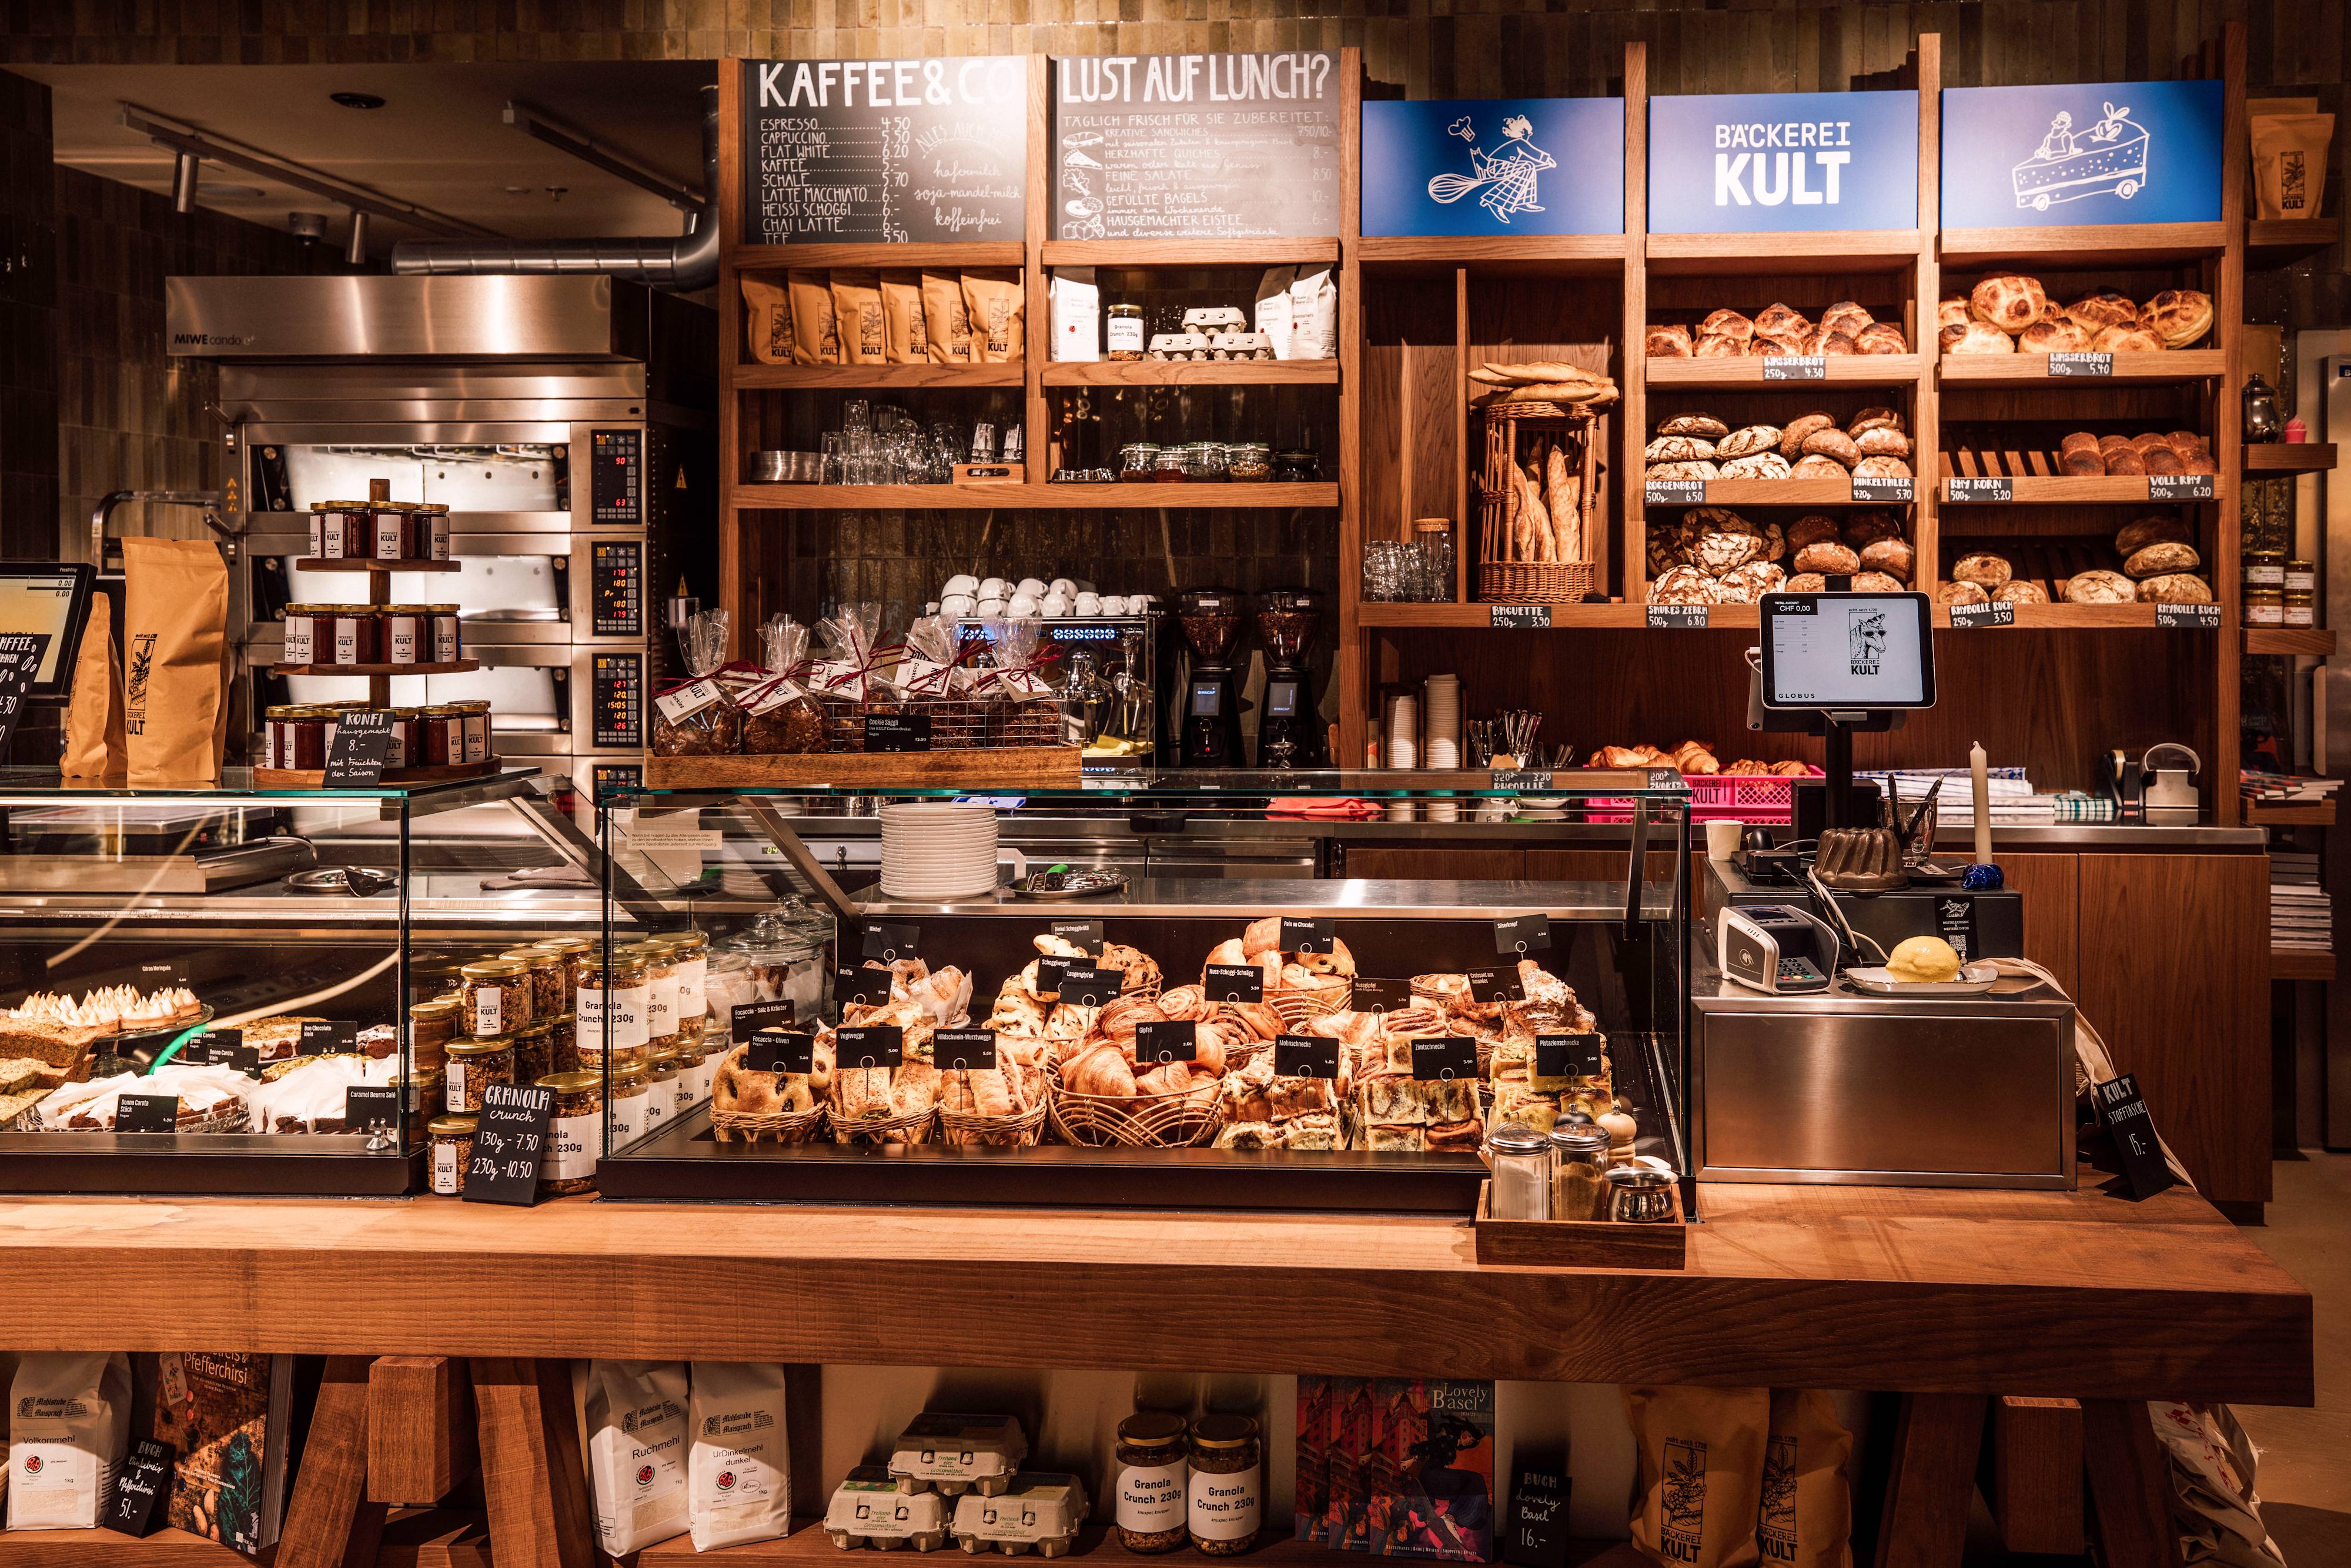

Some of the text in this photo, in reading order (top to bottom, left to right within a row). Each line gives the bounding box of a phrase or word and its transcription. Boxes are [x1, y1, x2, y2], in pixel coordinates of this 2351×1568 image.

[1062, 54, 1330, 103] LUST AUF LUNCH?
[761, 117, 911, 131] ESPRESSO 4.50
[1063, 112, 1329, 127] TÄGLICH FRISCH FÜR SIE ZUBEREITET:
[761, 131, 910, 145] CAPPUCCINO 5.50
[1715, 121, 1851, 148] BÄCKEREI
[762, 145, 908, 158] FLAT WHITE 6.20
[762, 159, 808, 172] KAFFEE
[763, 173, 908, 188] SCHALE 5.70
[1106, 169, 1191, 180] FEINE SALATE
[1715, 151, 1851, 208] KULT
[762, 188, 867, 202] LATTE MACCHIATO
[1106, 192, 1208, 206] GEFÜLLTE BAGELS
[763, 203, 851, 216] HEISSI SCHOGGI
[2282, 200, 2305, 209] KULT
[763, 218, 843, 232] CHAI LATTE
[934, 207, 1001, 232] koffeinfrei
[1107, 215, 1243, 226] HAUSGEMACHTER EISTEE
[174, 334, 208, 345] MIWE
[861, 346, 881, 355] KULT
[1764, 357, 1825, 366] WASSERBROT
[2050, 353, 2112, 363] WASSERBROT
[1764, 367, 1824, 379] 250g 4.30
[2050, 364, 2110, 375] 500g 5.40
[1647, 481, 1703, 490] ROGGENBROT
[1853, 479, 1911, 487] DINKELTALER
[1950, 479, 2001, 489] RHY KORN
[2151, 476, 2201, 486] VOLL RHY
[1647, 492, 1703, 503] 500g 6.50
[1853, 489, 1912, 499] 420g 5.70
[1951, 490, 2011, 501] 500g 5.20
[2151, 487, 2211, 498] 500g 6.20
[1492, 606, 1543, 616] BAGUETTE
[1683, 606, 1708, 615] ZEBRA
[1951, 601, 2014, 615] RHYBOLLE RUCH
[2158, 604, 2220, 615] RHYBOLLE RUCH
[1493, 617, 1550, 627] 250g 3.90
[1649, 616, 1705, 627] 500g 6.80
[1953, 611, 2012, 627] 250g 3.50
[2158, 615, 2218, 626] 500g 4.50
[1851, 666, 1880, 675] KULT
[671, 692, 684, 708] Cookies
[346, 713, 384, 726] KONFI
[336, 727, 390, 735] hausgemacht
[349, 739, 366, 751] 8.-
[348, 757, 382, 767] Früchten
[349, 768, 374, 777] Saison
[1692, 778, 1721, 787] BÄCKEREI
[1692, 788, 1721, 804] KULT
[2103, 1078, 2133, 1104] KULT
[485, 1085, 550, 1111] GRANOLA
[490, 1109, 536, 1123] crunch
[2108, 1100, 2146, 1125] STOFFTASCHE
[480, 1132, 539, 1154] 130g 7.50
[184, 1352, 248, 1384] Pfefferchirsi
[1444, 1383, 1488, 1402] Lovely
[1433, 1389, 1477, 1411] Basel
[23, 1435, 75, 1445] Vollkornmehl
[138, 1441, 163, 1457] BUCH
[633, 1435, 680, 1459] Ruchmehl
[713, 1444, 764, 1458] UrDinkelmehl
[725, 1456, 751, 1466] dunkel
[1135, 1478, 1171, 1489] Granola
[1124, 1489, 1181, 1504] Crunch 230g
[1661, 1526, 1701, 1544] BÄCKEREI
[1661, 1535, 1701, 1563] KULT
